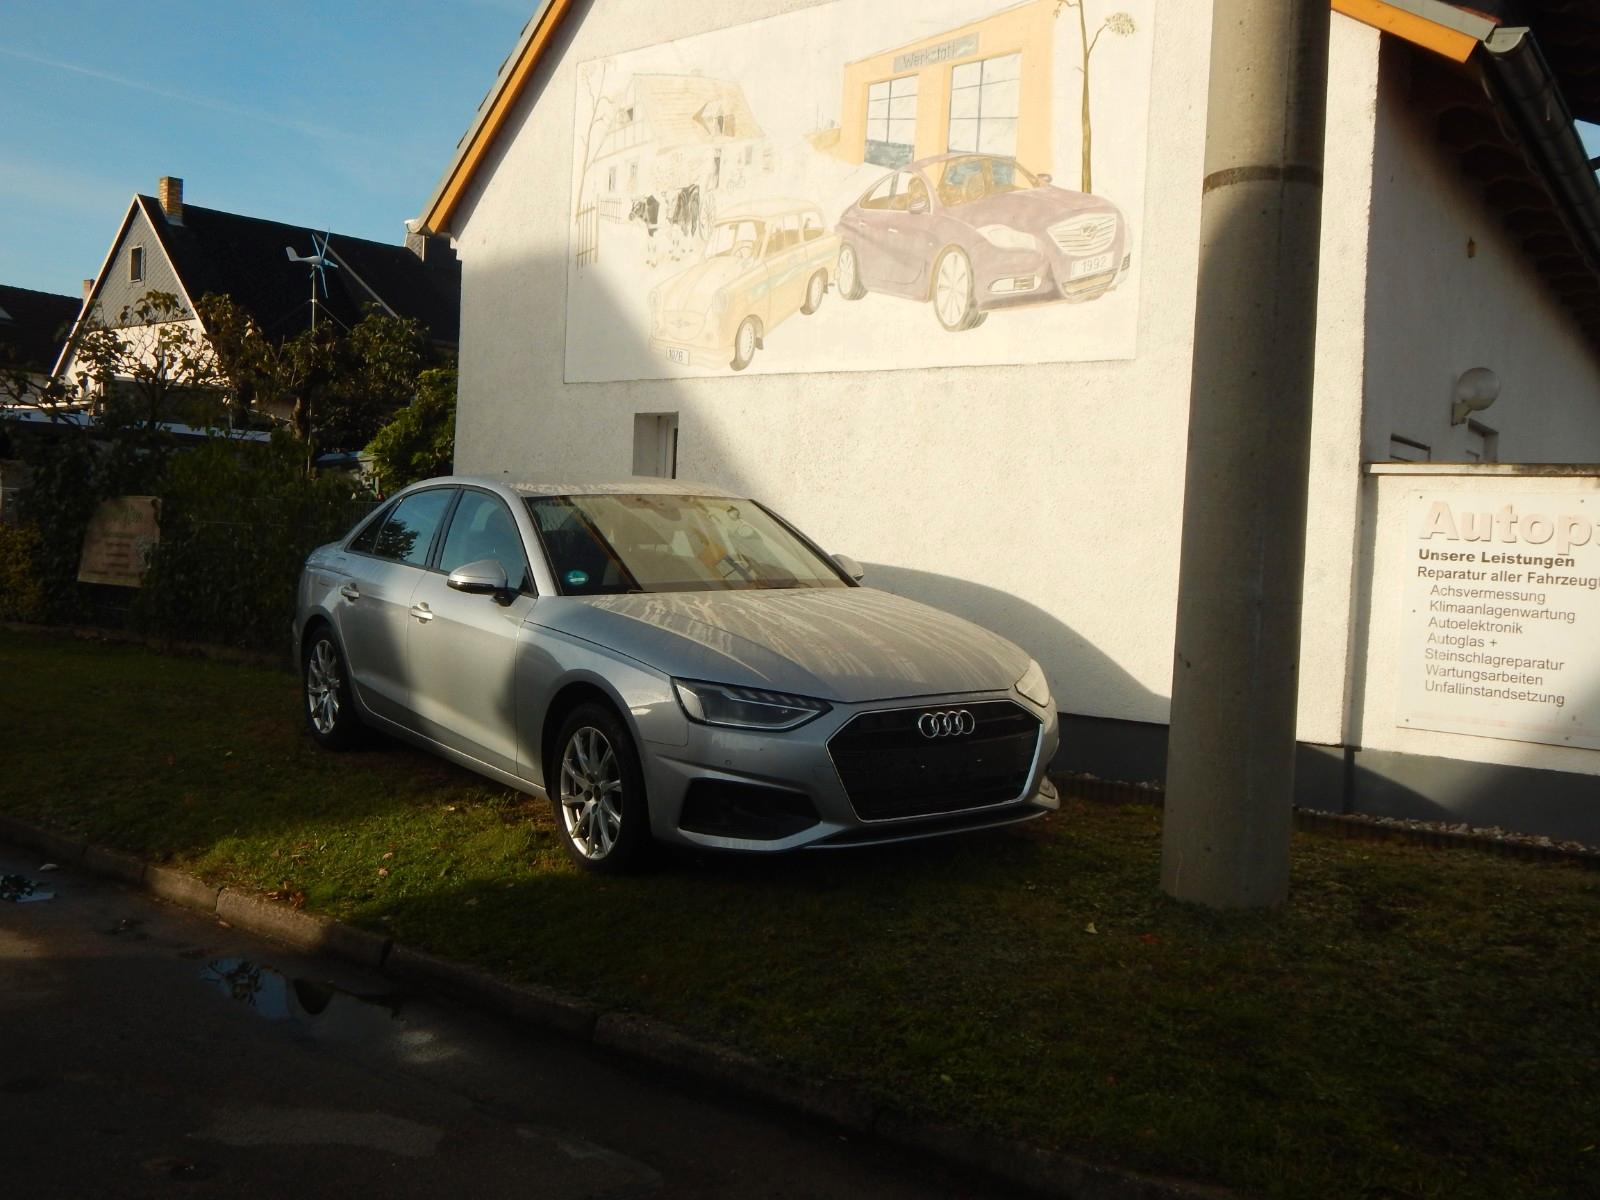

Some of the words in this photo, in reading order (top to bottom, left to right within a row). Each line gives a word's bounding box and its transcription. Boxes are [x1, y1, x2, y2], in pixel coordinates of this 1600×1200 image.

[1419, 501, 1600, 556] Autop
[1418, 549, 1475, 563] Unsere
[1481, 551, 1575, 569] Leistungen
[1417, 566, 1487, 581] Reparatur
[1491, 570, 1523, 583] aller
[1527, 571, 1600, 590] Fahrzeug
[1430, 584, 1546, 605] Achsvermessung
[1430, 600, 1576, 624] Klimaanlagenwartung
[1428, 616, 1523, 634] Autoelektronik
[1427, 632, 1485, 649] Autoglas
[1425, 648, 1565, 671] Steinschlagreparatur
[1425, 664, 1543, 685] Wartungsarbeiten
[1425, 680, 1565, 707] Unfallinstandsetzung
